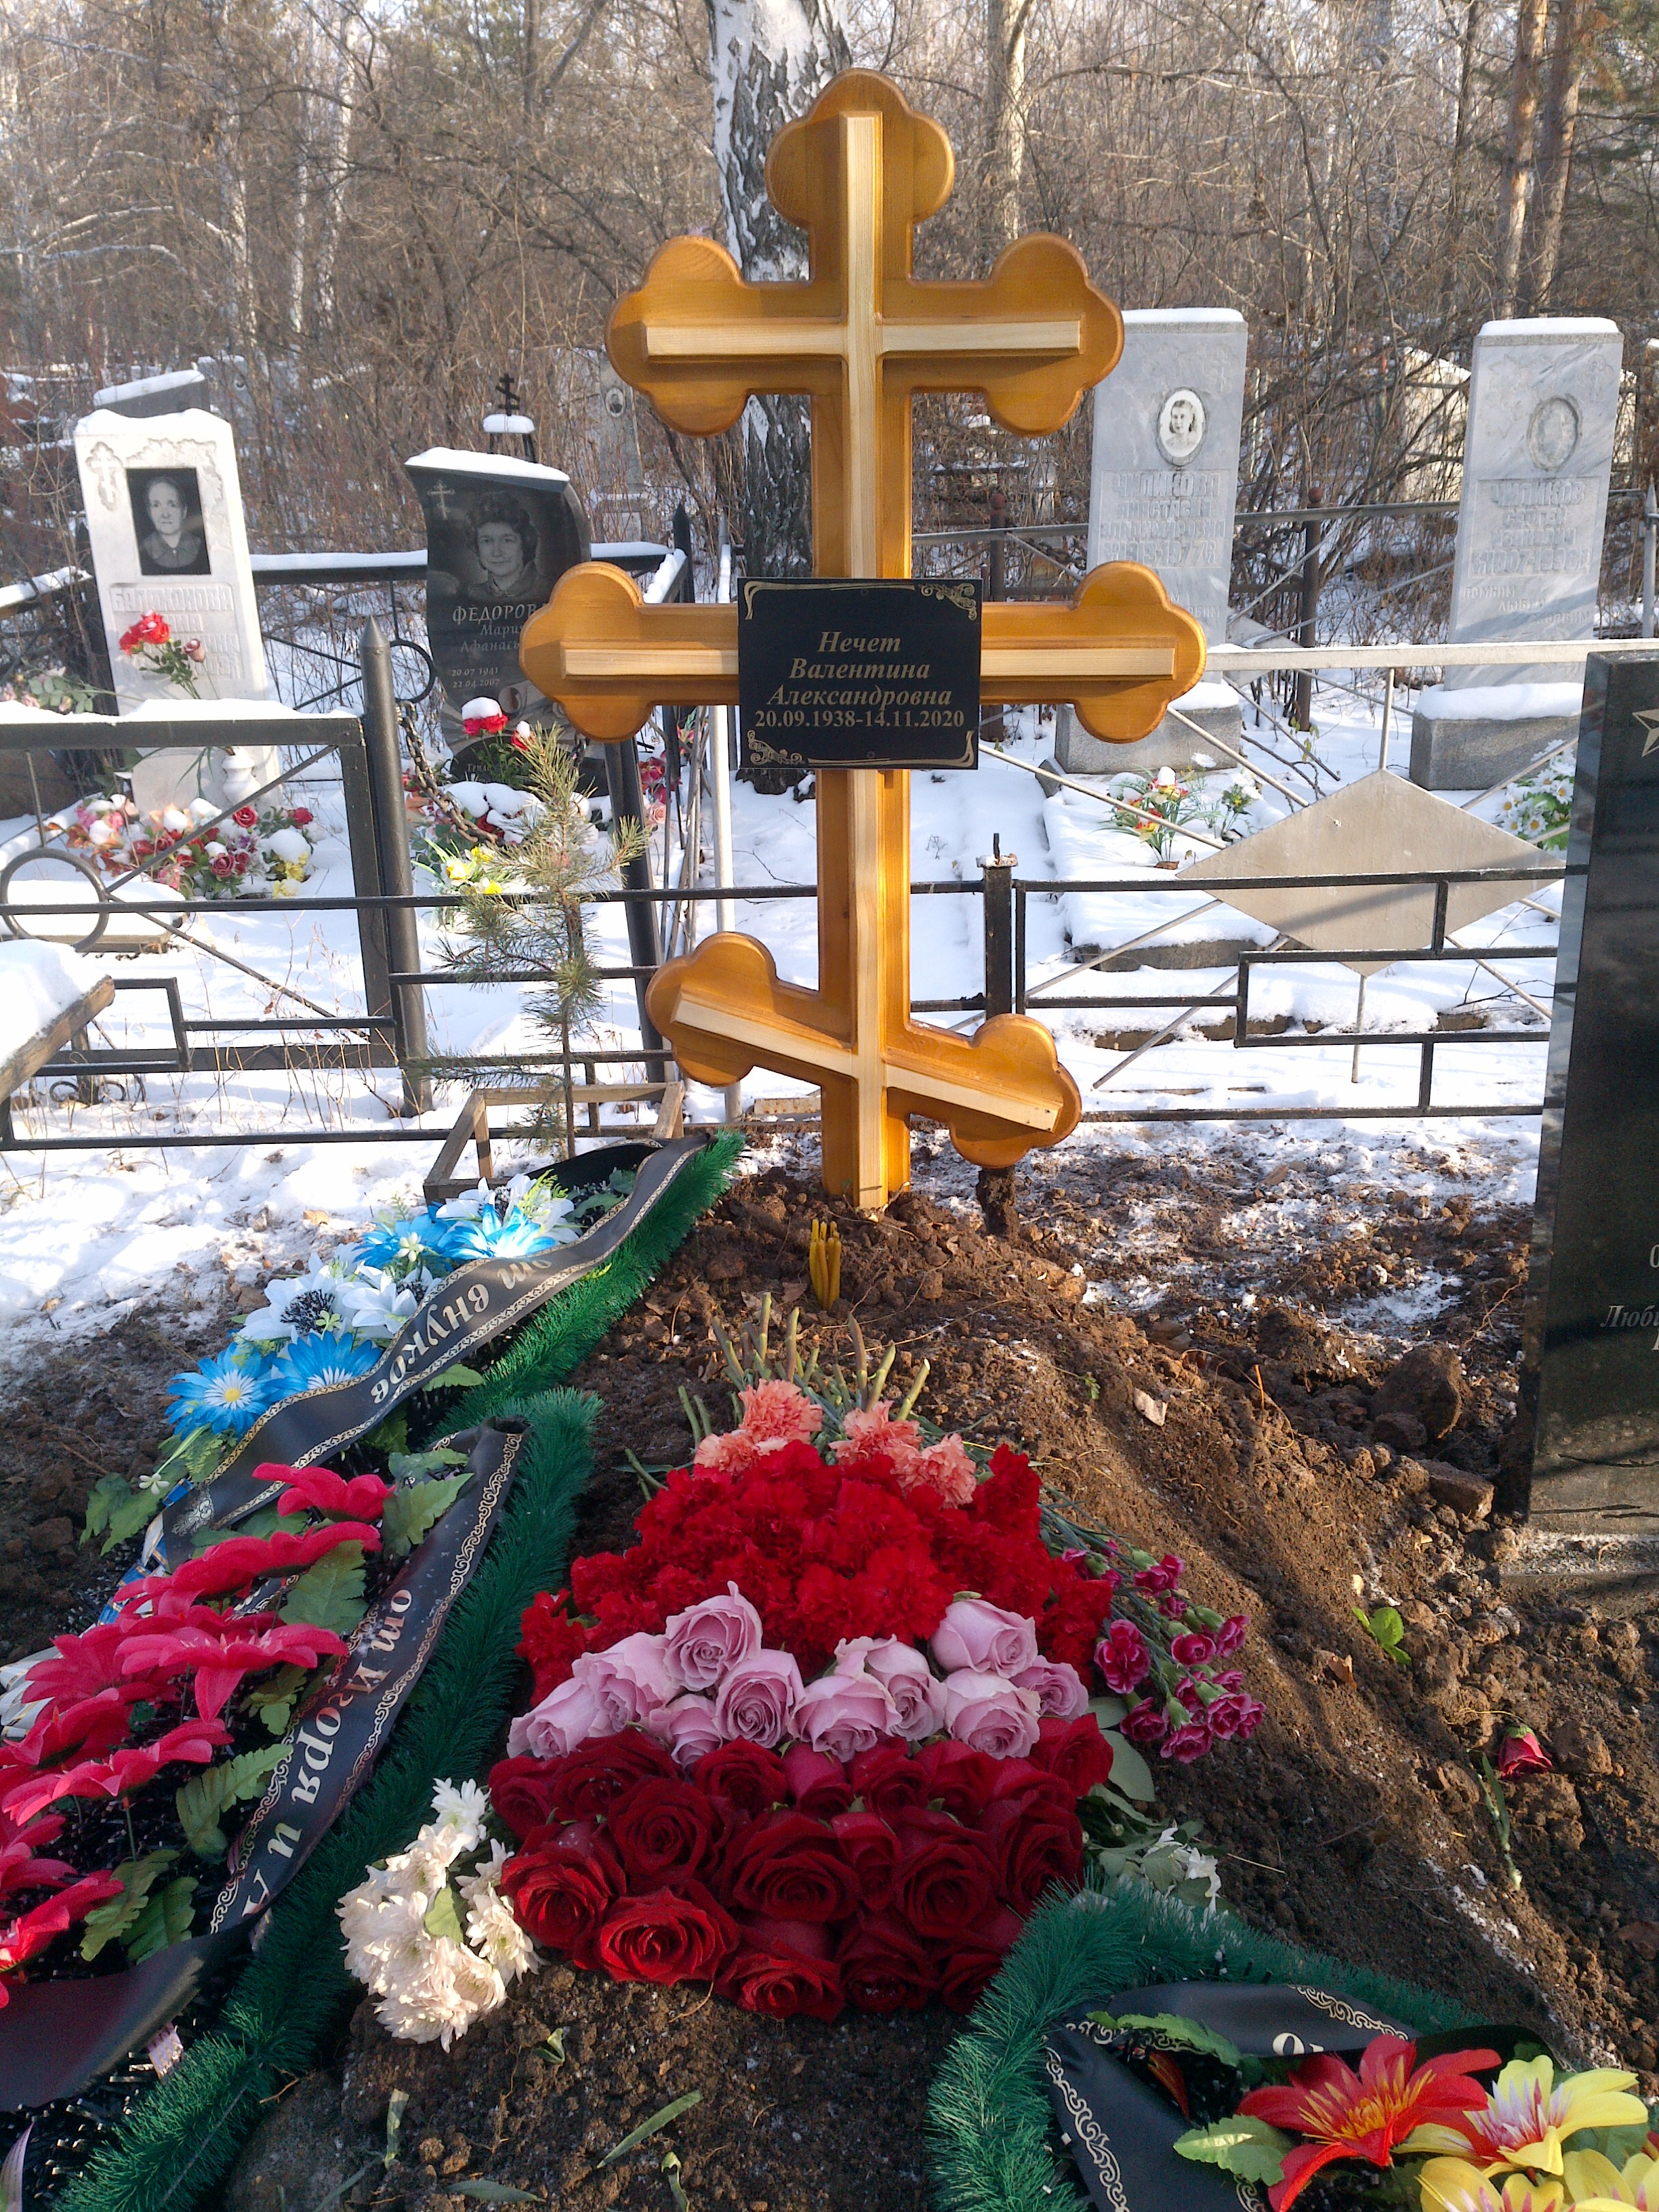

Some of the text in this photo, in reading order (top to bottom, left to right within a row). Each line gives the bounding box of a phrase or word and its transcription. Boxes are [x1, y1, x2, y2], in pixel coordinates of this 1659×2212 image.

[452, 602, 546, 625] ФЕДОРОВ
[480, 623, 522, 638] Мари
[817, 630, 902, 653] Нечет
[787, 657, 930, 680] Валентина
[766, 683, 953, 712] Александровна
[754, 710, 965, 728] 20.09.1938-14.11.2020
[370, 1259, 552, 1405] от внуков
[267, 1588, 413, 1860] от Игоря и
